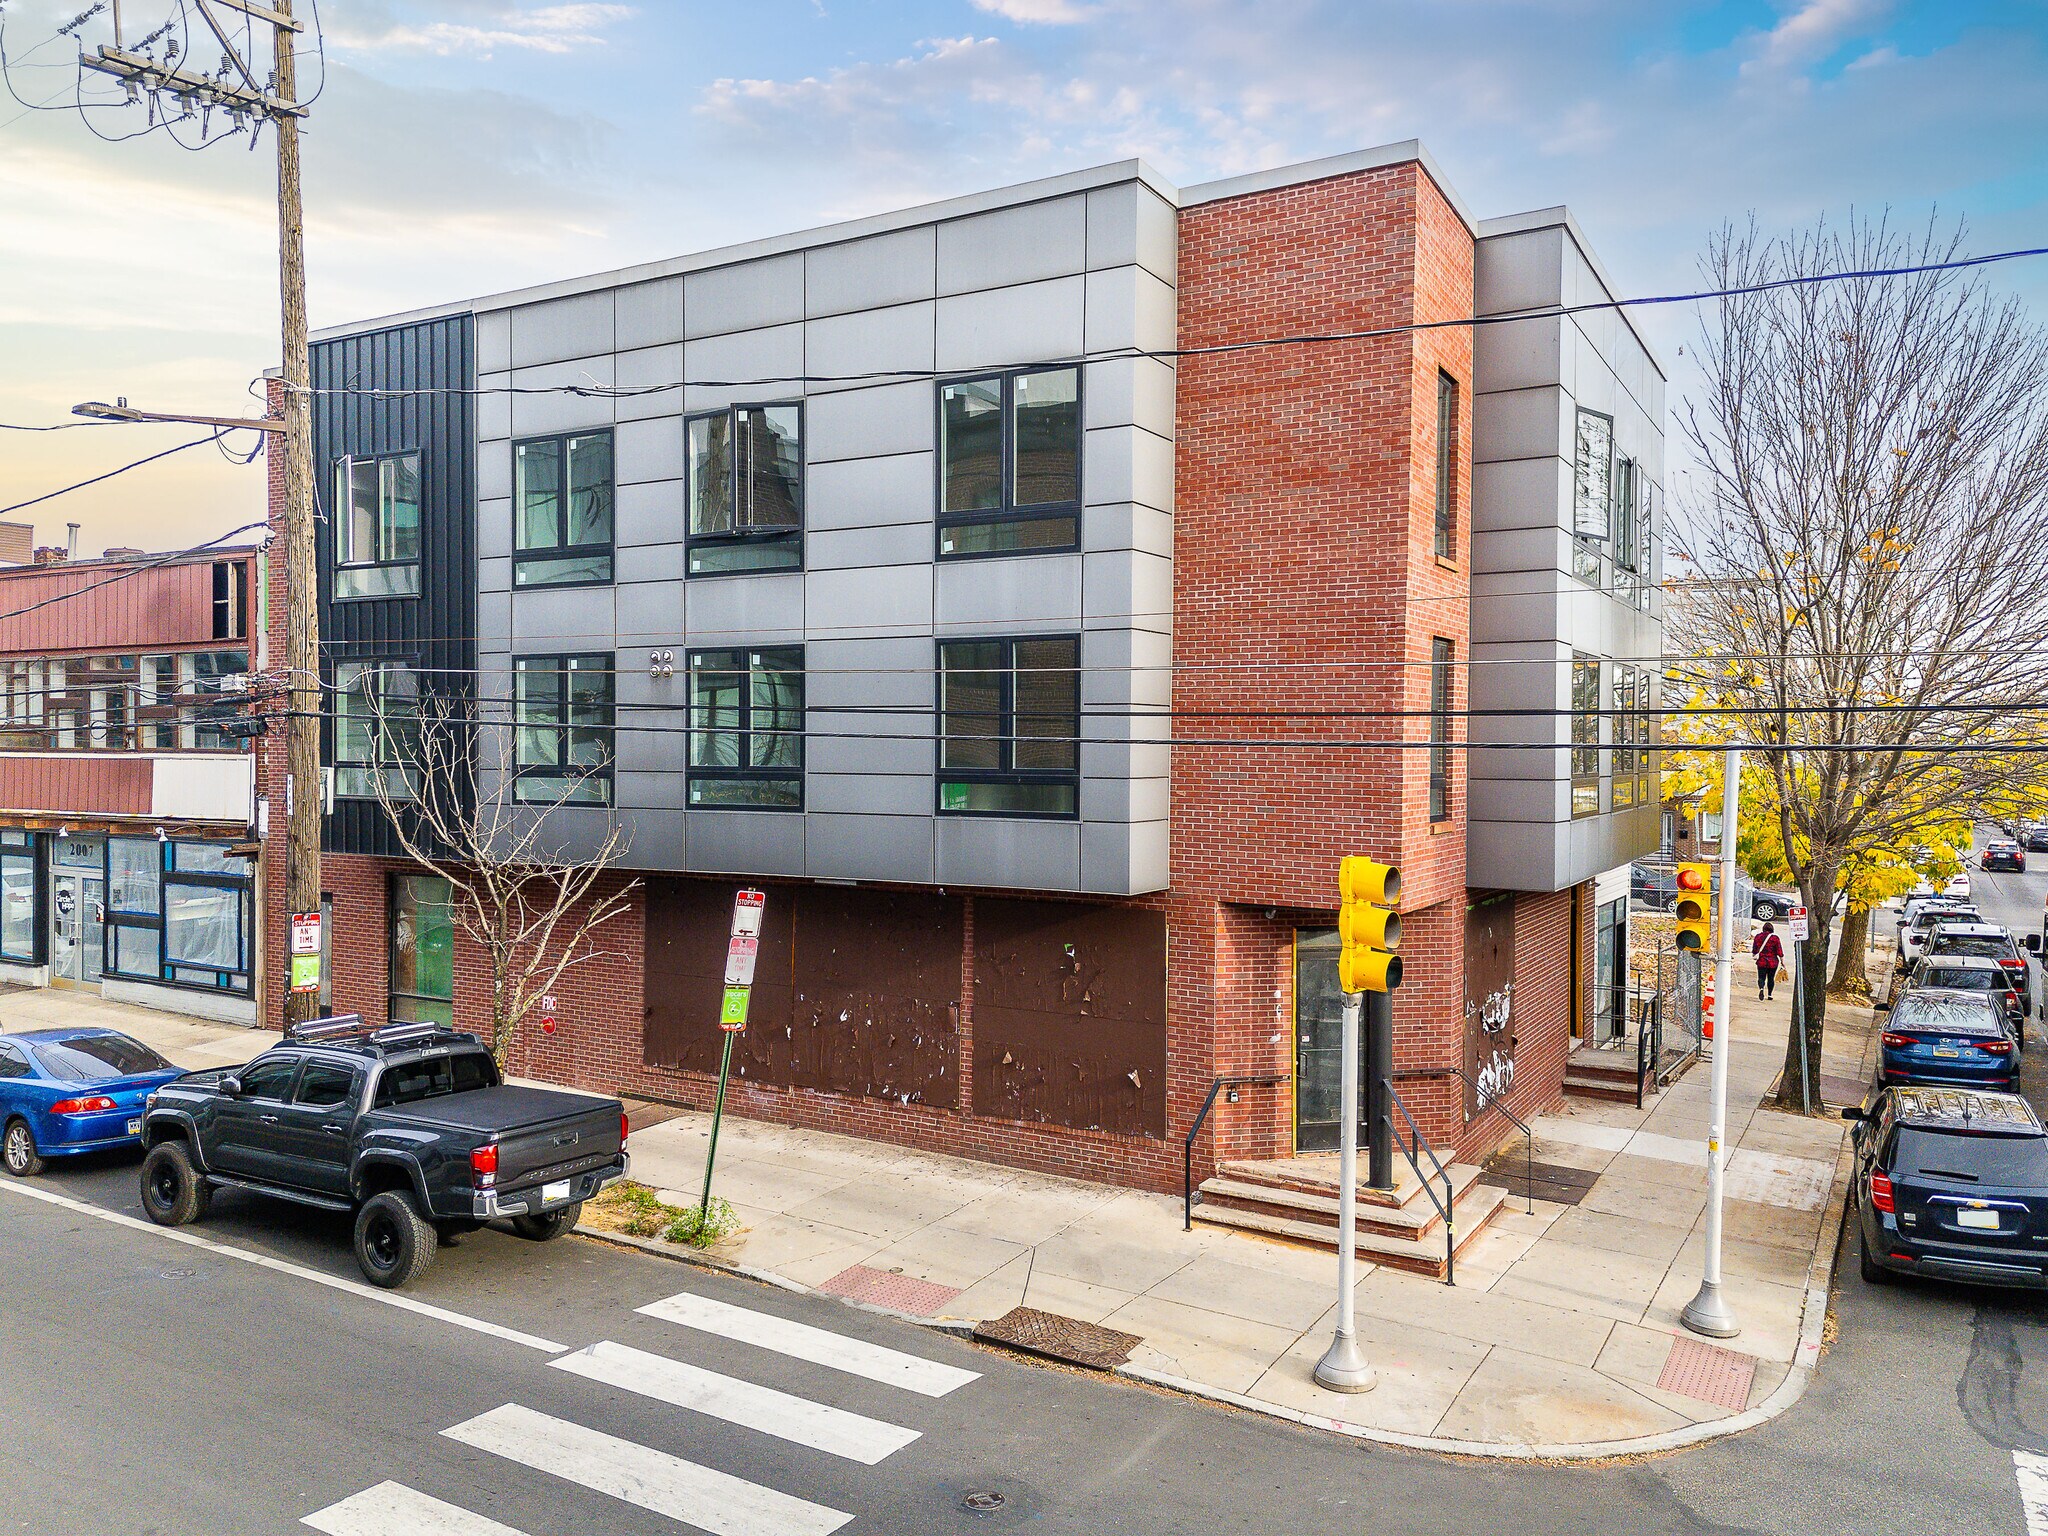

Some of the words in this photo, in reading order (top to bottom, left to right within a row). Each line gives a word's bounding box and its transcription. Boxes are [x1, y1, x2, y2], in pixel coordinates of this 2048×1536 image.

[70, 843, 94, 857] 2007
[61, 902, 75, 910] Hope
[737, 899, 762, 907] STOPPING
[299, 936, 314, 944] TIME
[542, 996, 558, 1011] FDC
